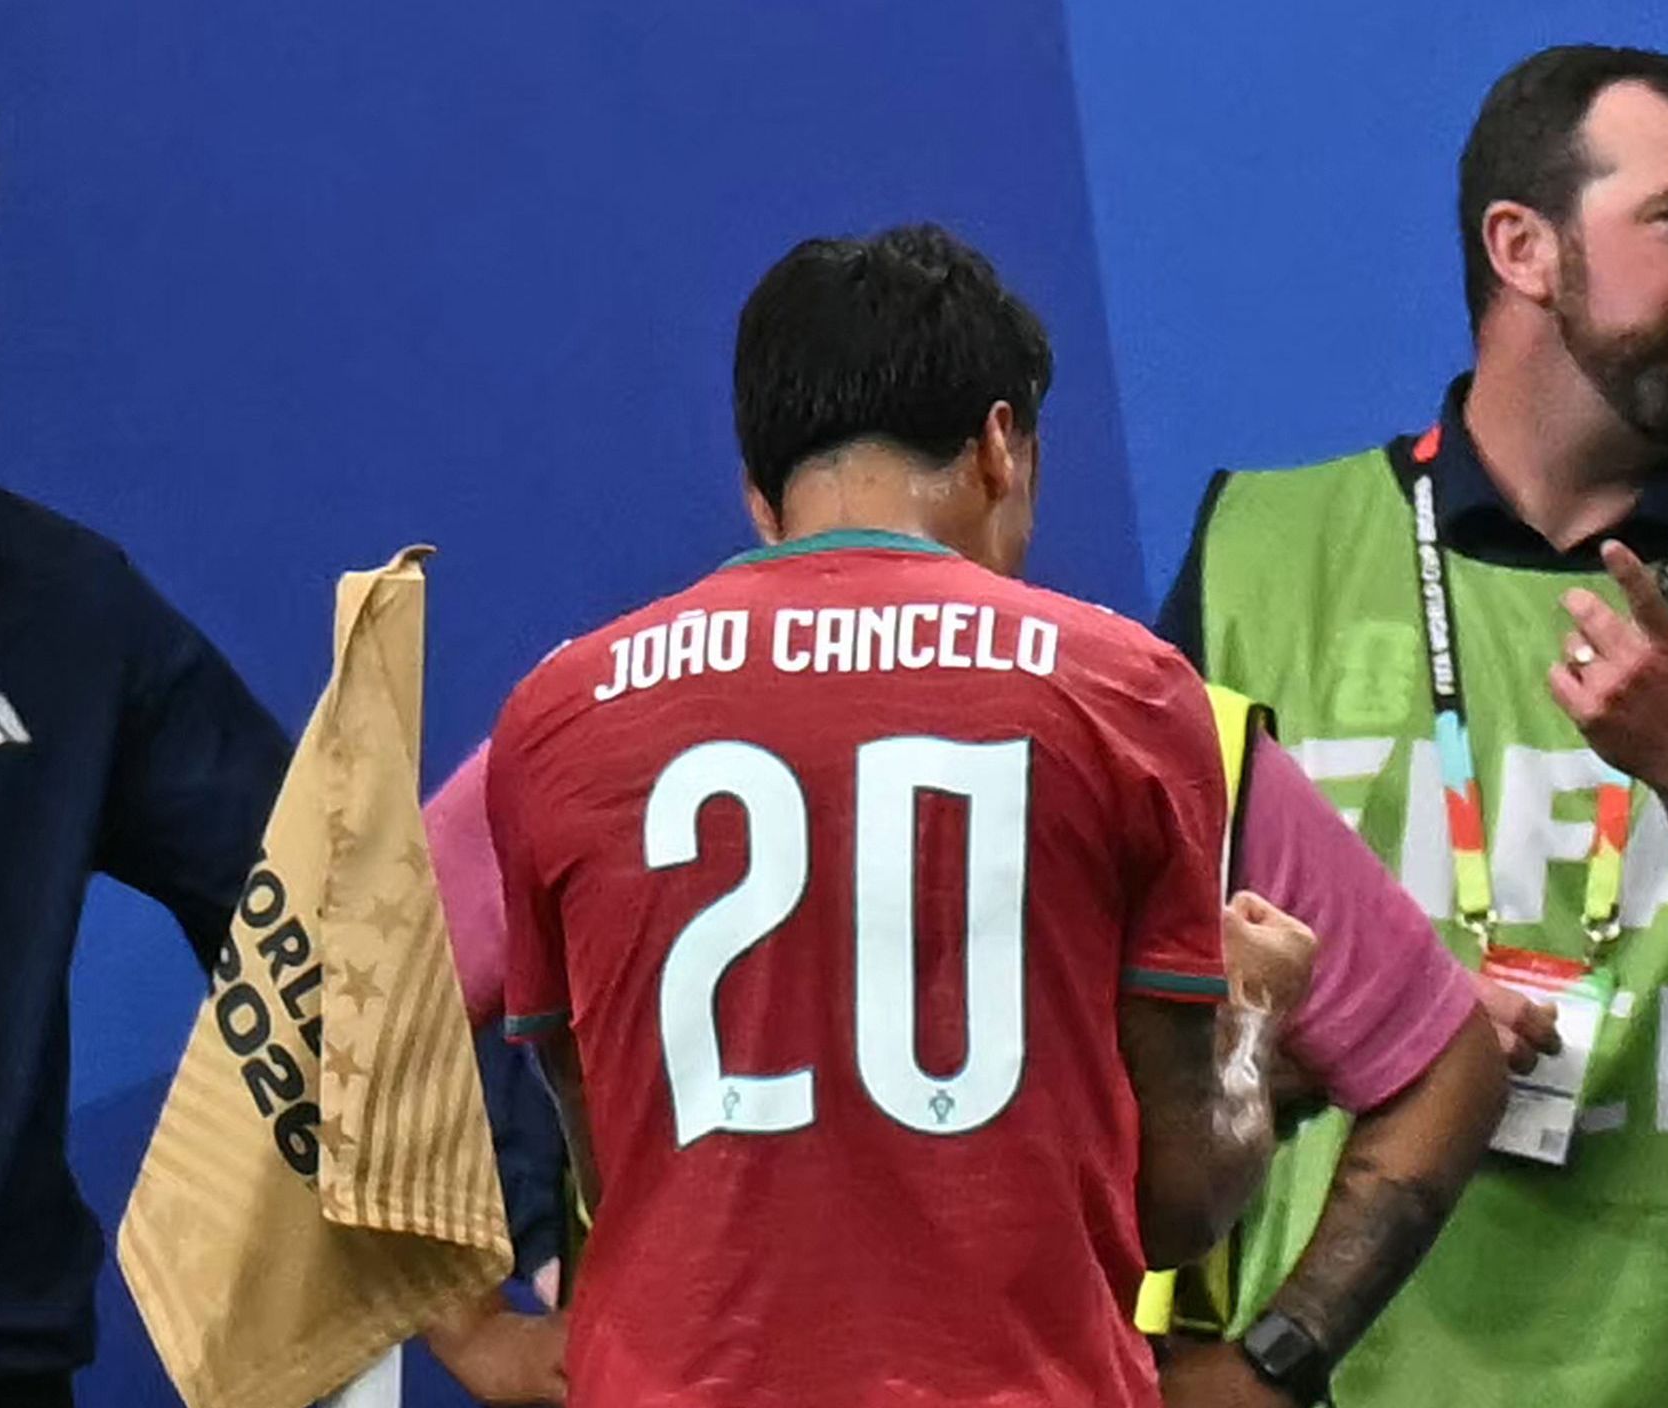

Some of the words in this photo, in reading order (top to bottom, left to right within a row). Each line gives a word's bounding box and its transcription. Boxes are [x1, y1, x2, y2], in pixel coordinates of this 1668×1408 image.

[595, 608, 749, 701] JOÃO
[772, 603, 1058, 676] CANCELO
[240, 845, 323, 1060] ORL
[644, 735, 1030, 1148] 20
